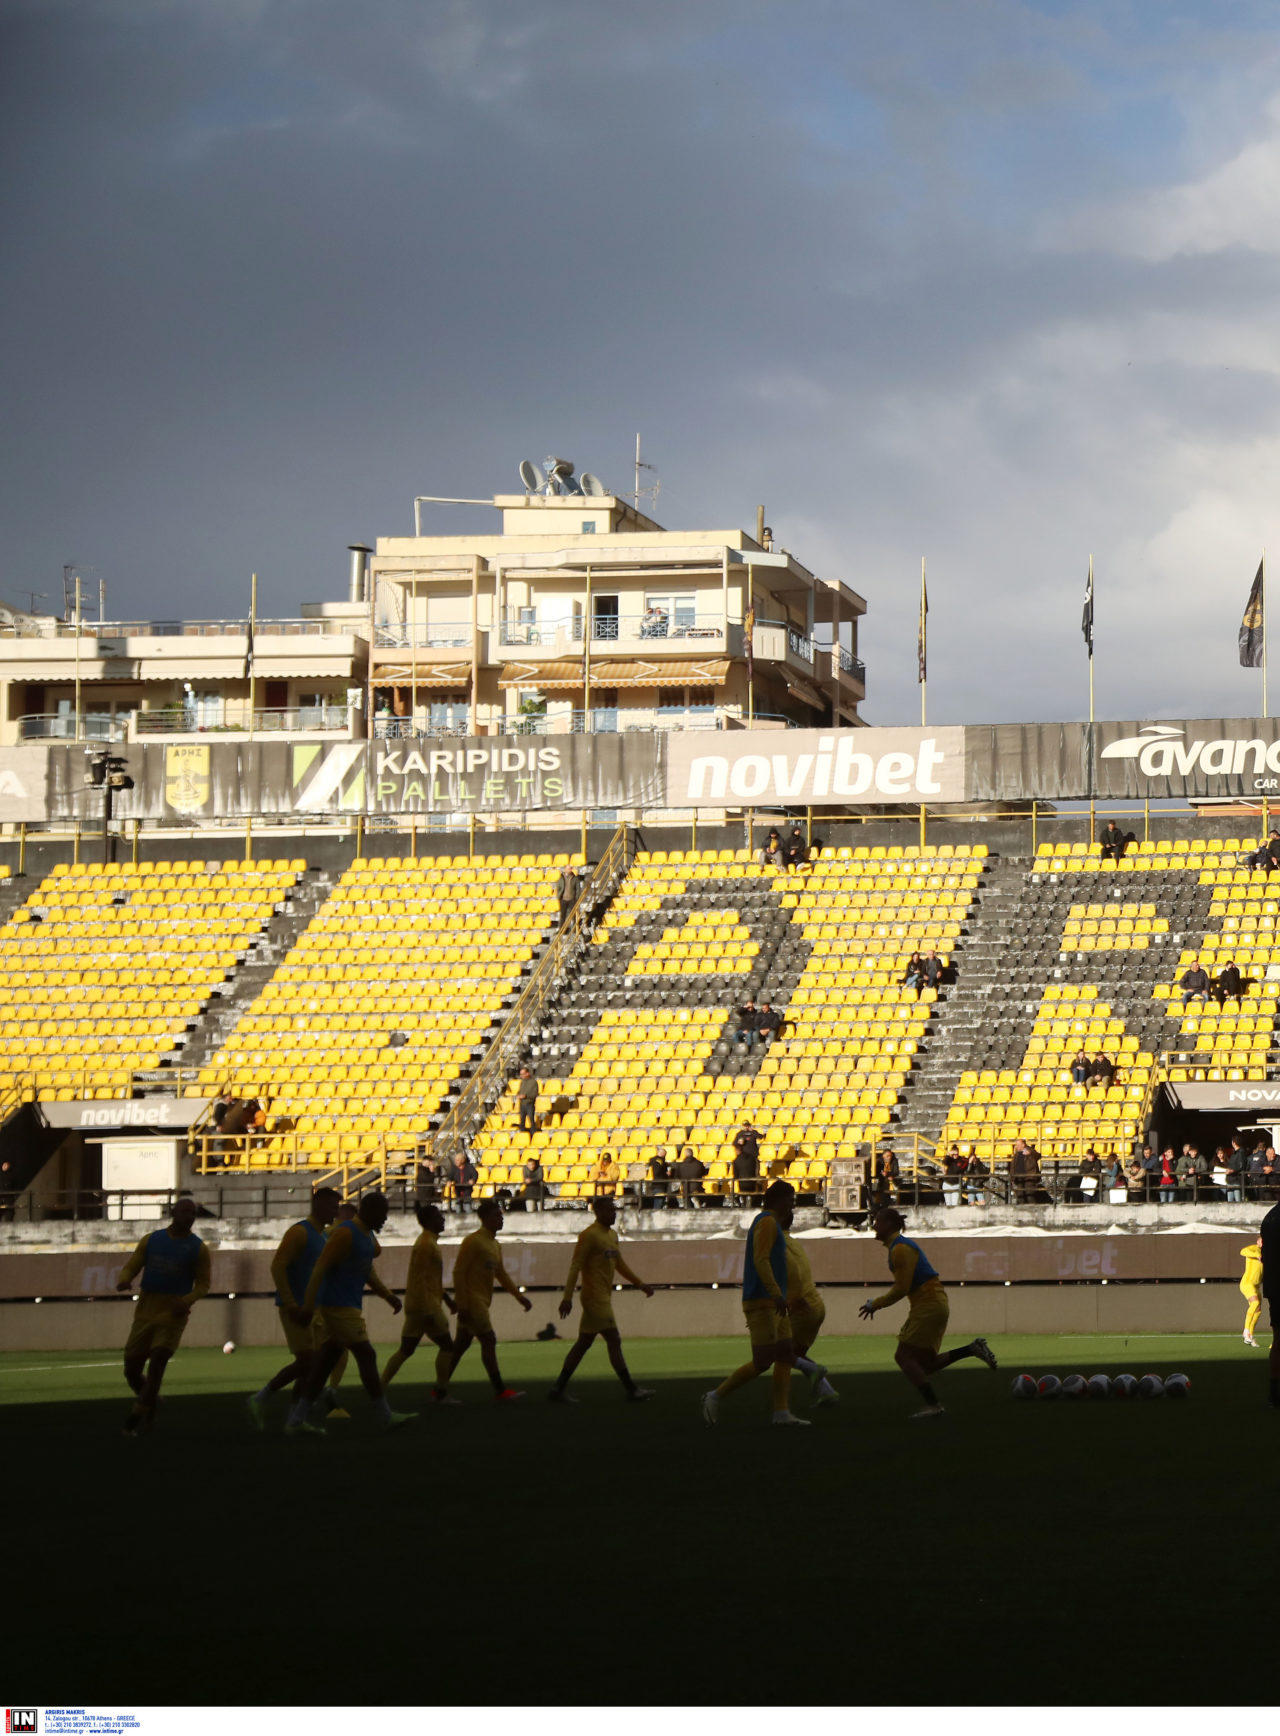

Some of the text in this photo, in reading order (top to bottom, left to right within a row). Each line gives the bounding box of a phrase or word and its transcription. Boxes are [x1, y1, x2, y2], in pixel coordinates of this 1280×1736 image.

[376, 747, 562, 775] KARIPIDIS
[686, 735, 945, 798] novibet
[377, 777, 564, 801] PALLETS
[1254, 778, 1279, 789] CAR
[80, 1103, 171, 1126] novibet
